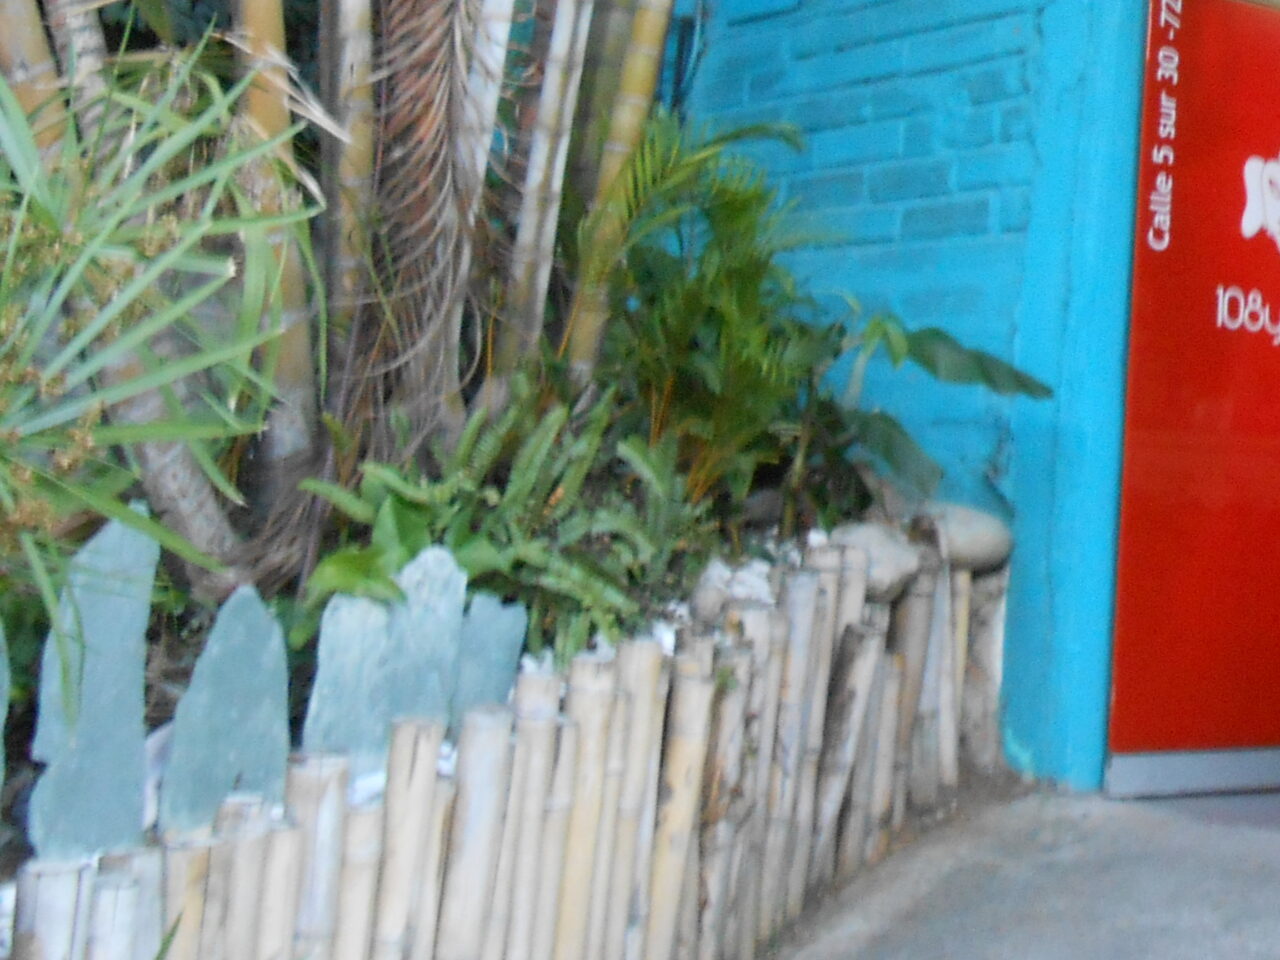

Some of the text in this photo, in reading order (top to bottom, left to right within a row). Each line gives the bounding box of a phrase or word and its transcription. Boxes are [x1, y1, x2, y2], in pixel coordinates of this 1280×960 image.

[1160, 90, 1177, 139] sur
[1152, 144, 1174, 166] 5
[1147, 171, 1173, 252] Calle
